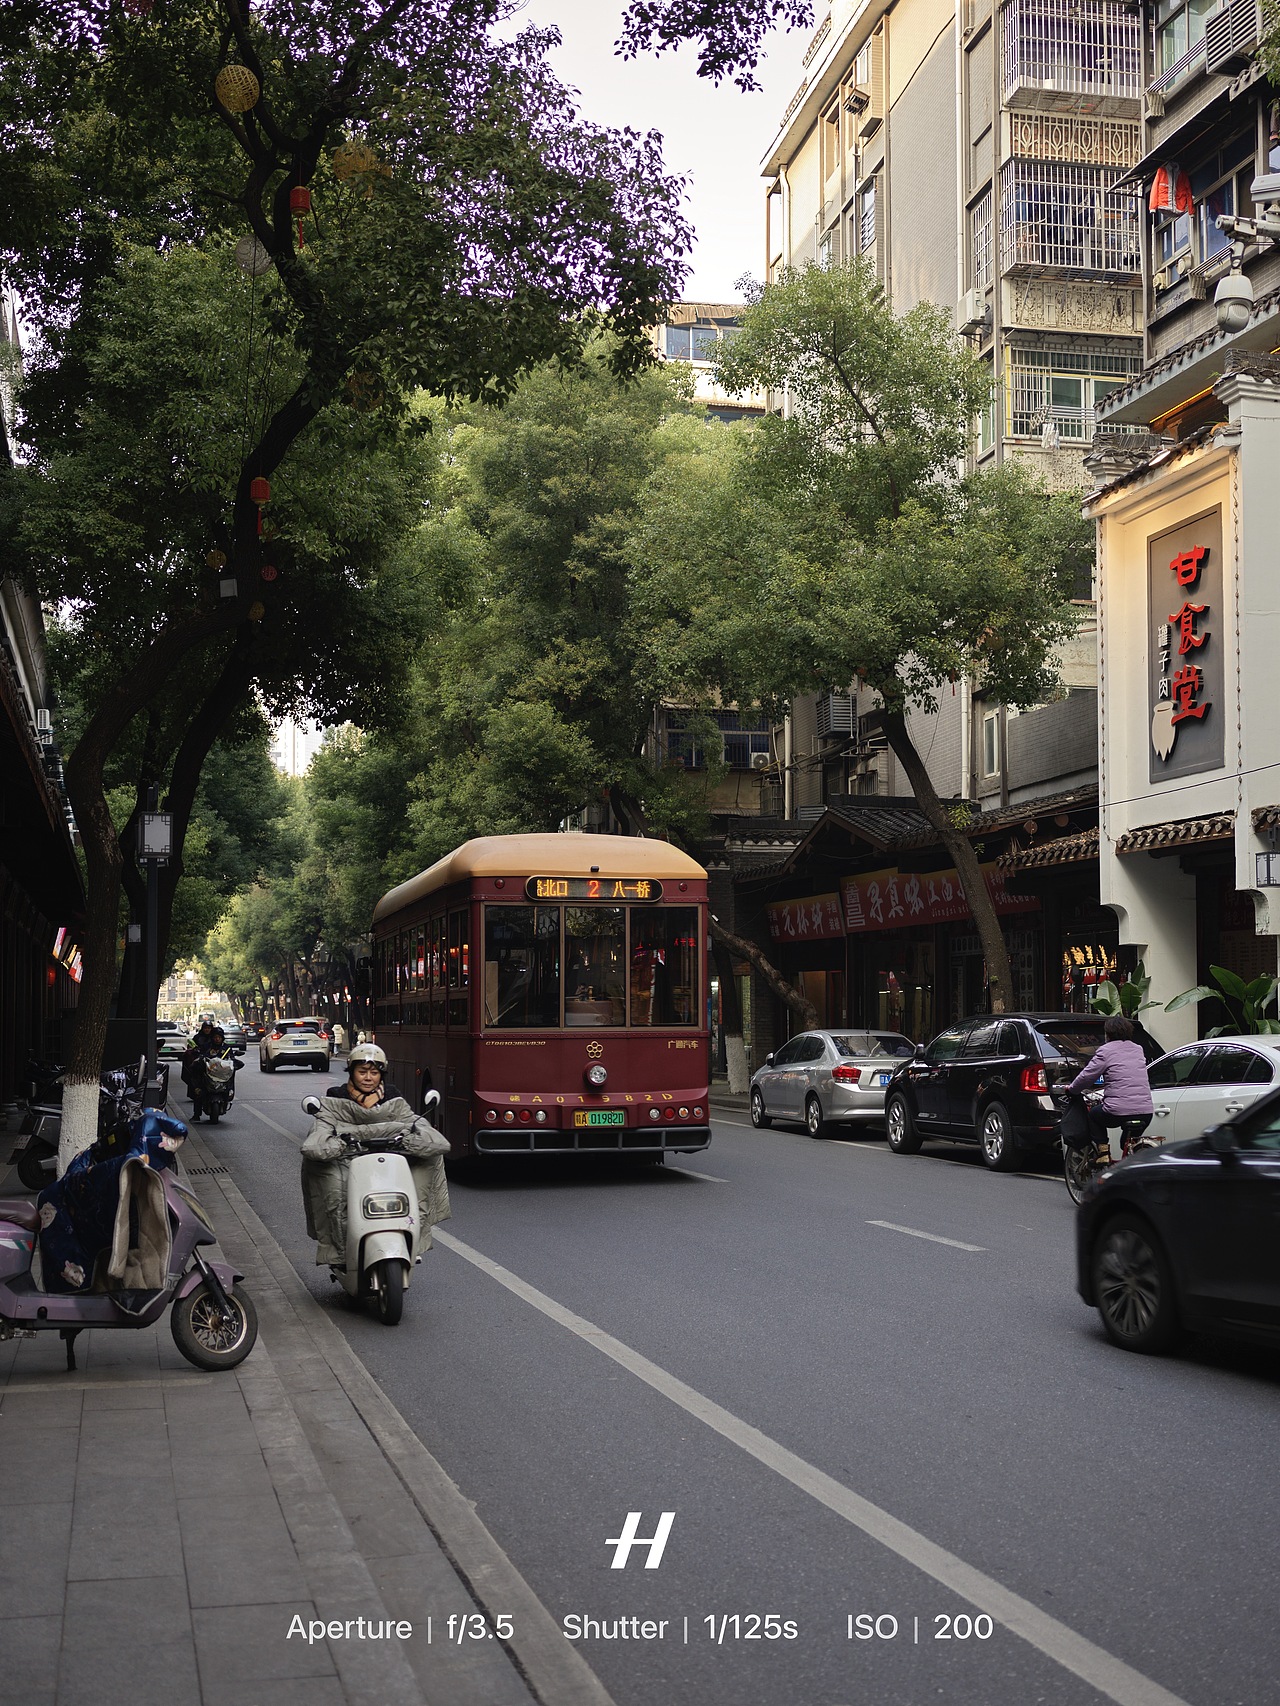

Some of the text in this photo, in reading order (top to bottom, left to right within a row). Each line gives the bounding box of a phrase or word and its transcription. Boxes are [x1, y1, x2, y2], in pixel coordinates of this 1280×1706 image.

[1169, 544, 1212, 726] 甘食堂
[589, 880, 600, 898] 2
[612, 880, 651, 898] 八一桥
